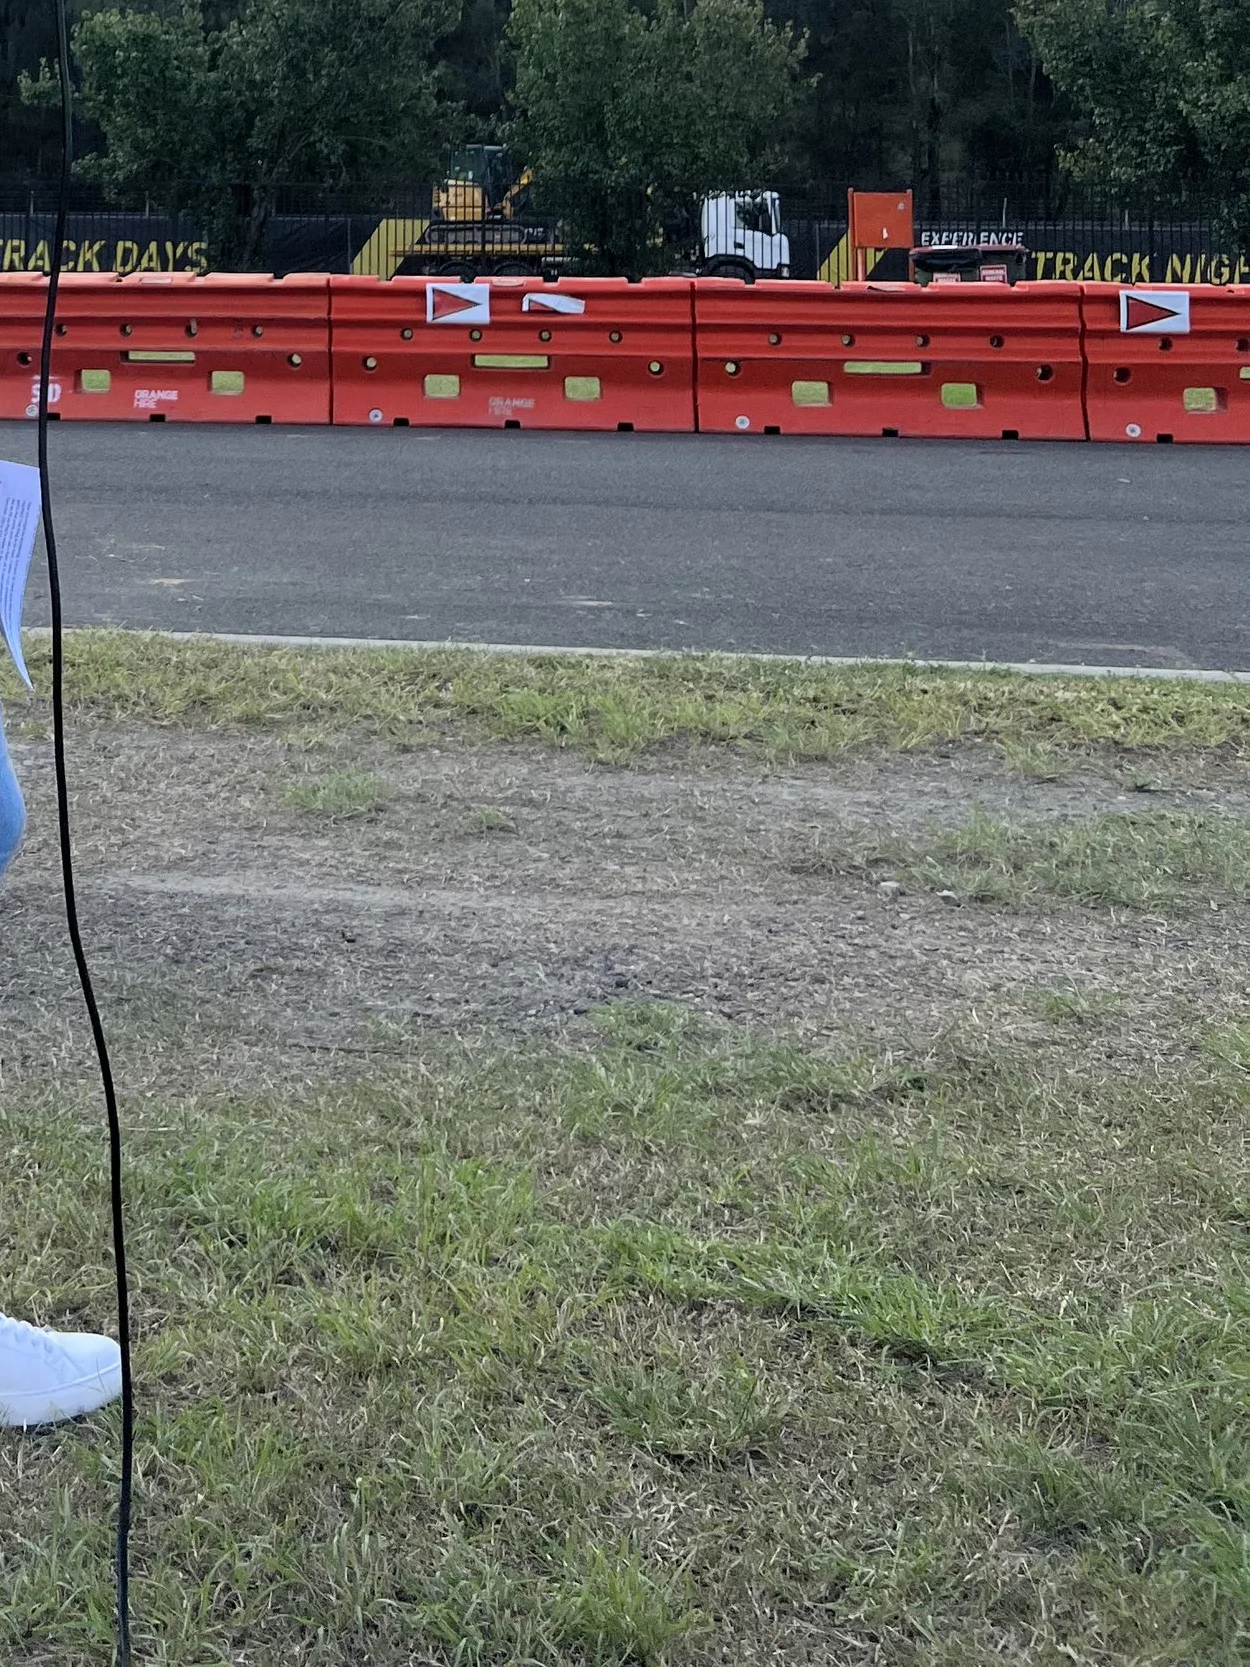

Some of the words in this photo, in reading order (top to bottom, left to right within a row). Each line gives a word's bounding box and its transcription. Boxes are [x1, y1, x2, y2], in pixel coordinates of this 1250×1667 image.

[921, 231, 1024, 246] EXPERIENCE
[113, 240, 209, 273] DAYS
[1031, 251, 1152, 283] TRACK
[1165, 253, 1250, 285] NIGH
[134, 389, 178, 401] ORANGE
